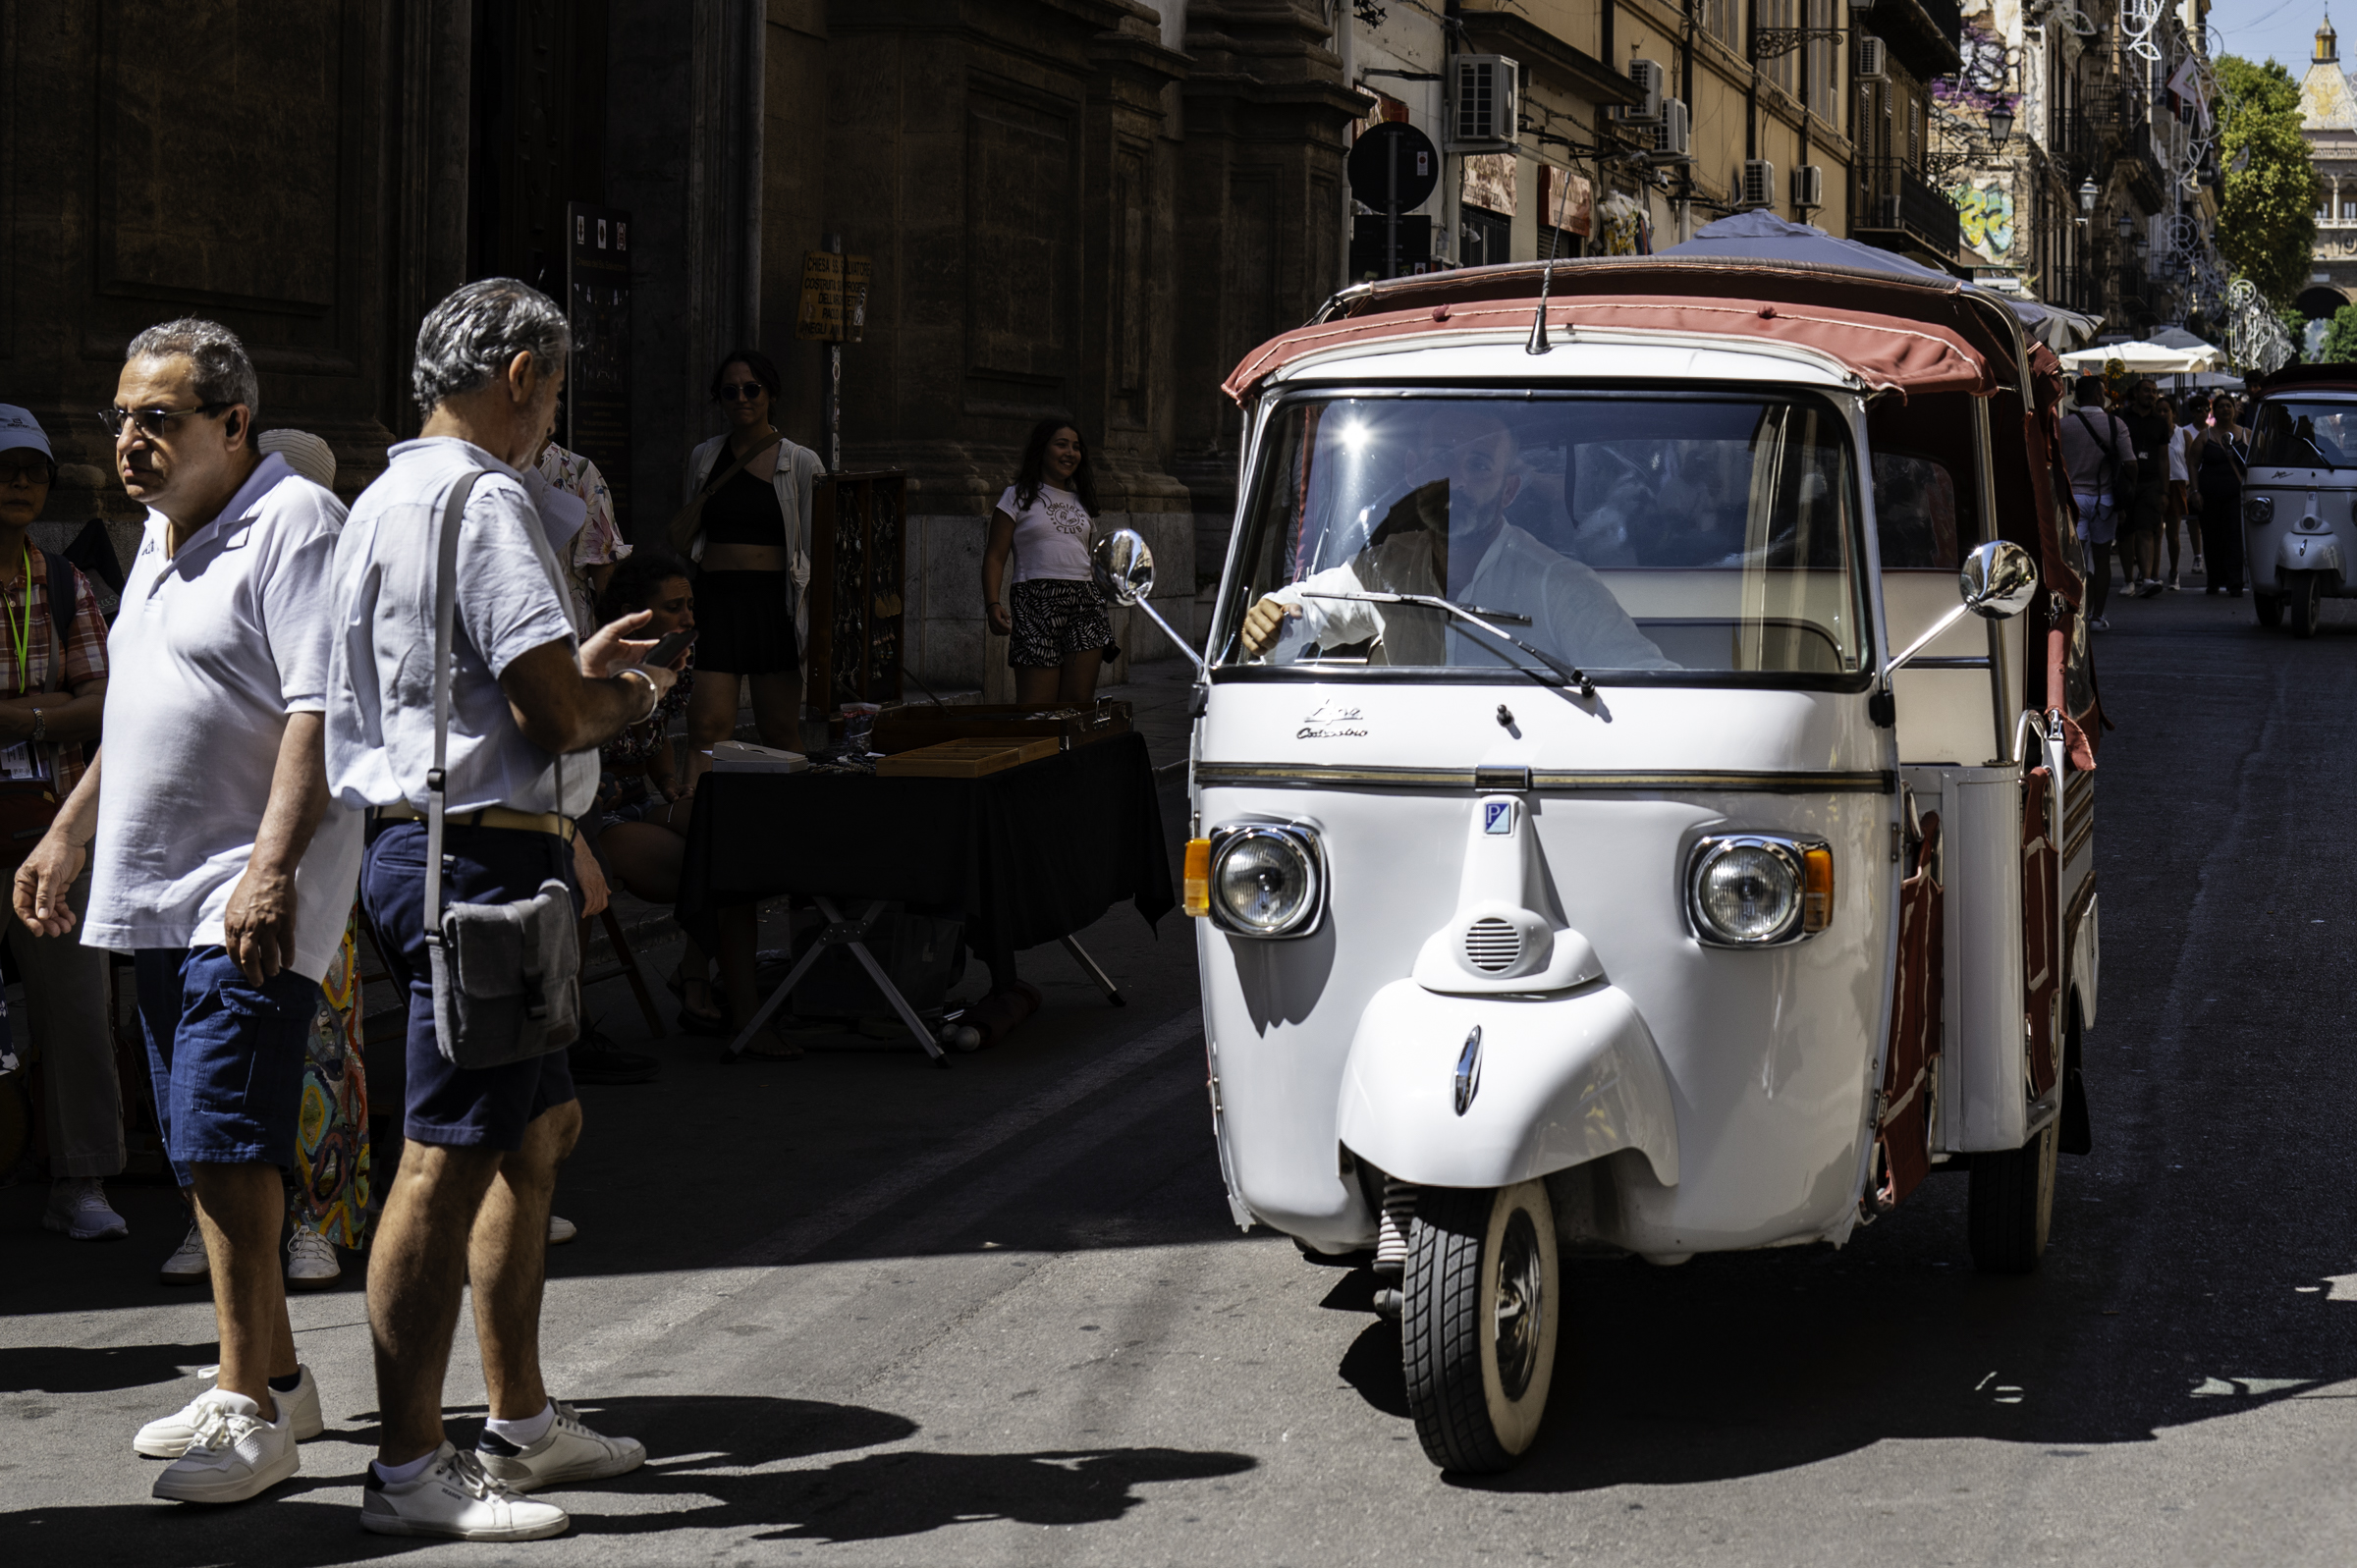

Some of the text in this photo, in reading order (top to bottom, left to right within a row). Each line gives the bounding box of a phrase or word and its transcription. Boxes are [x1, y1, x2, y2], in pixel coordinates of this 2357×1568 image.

[807, 257, 830, 273] CHIESA
[804, 278, 837, 292] COSTRUITA
[822, 308, 839, 320] PAOLO
[1046, 502, 1086, 518] COWGIRLS
[1056, 524, 1083, 534] CLUB
